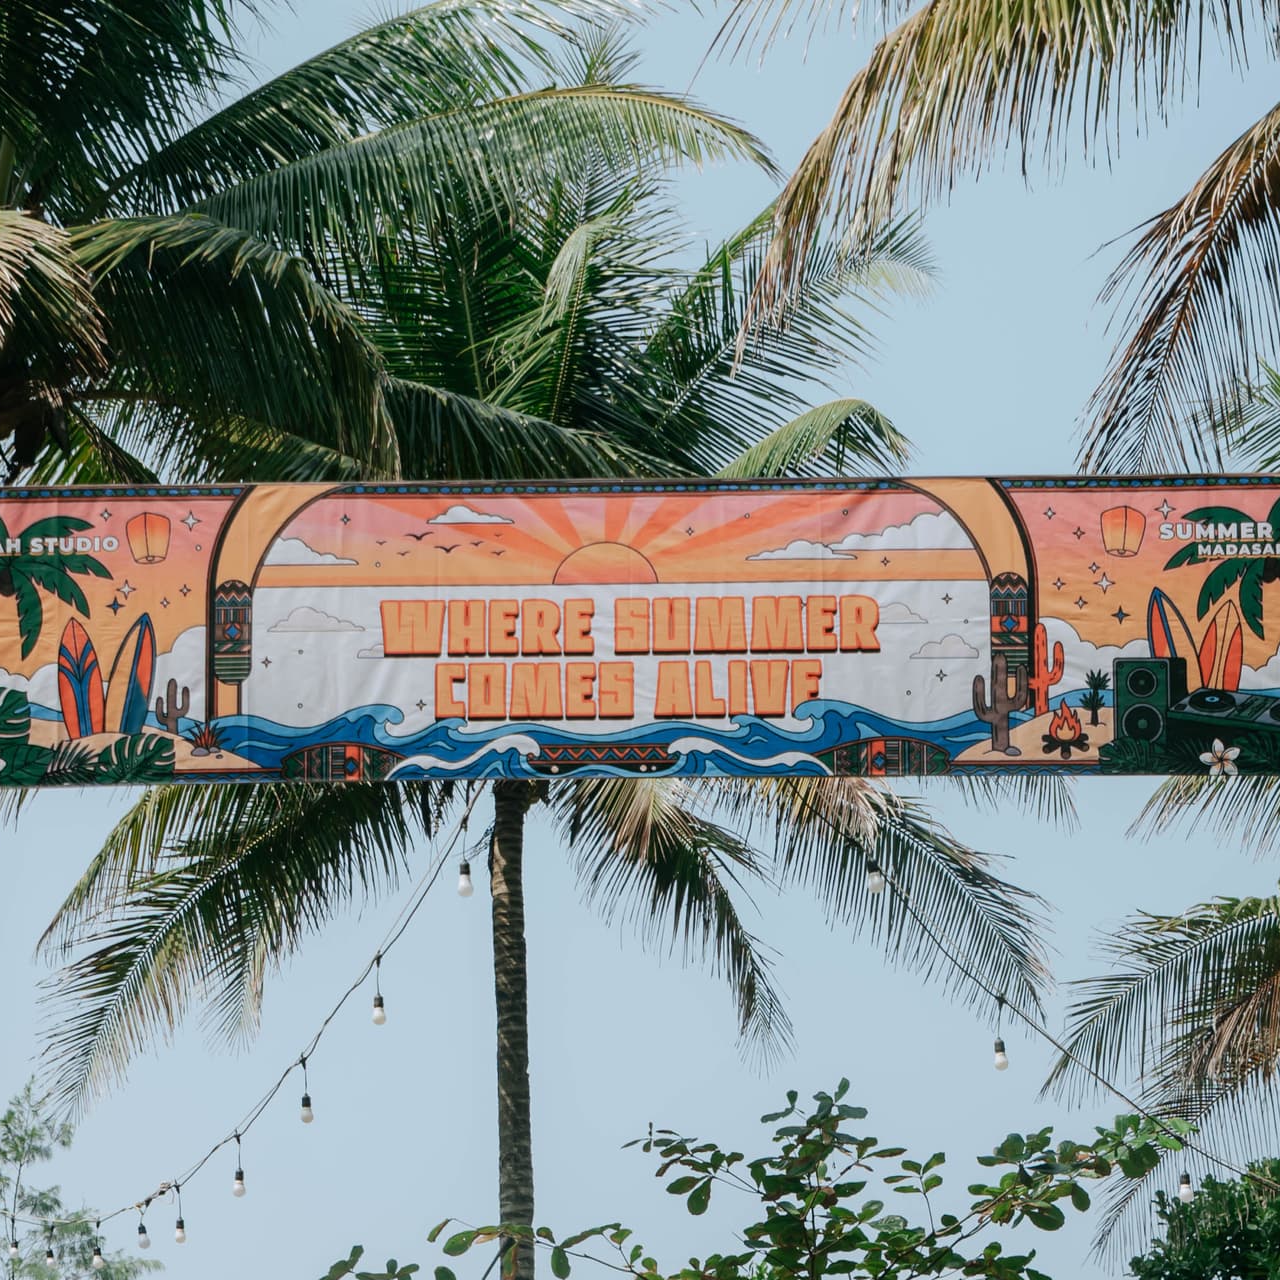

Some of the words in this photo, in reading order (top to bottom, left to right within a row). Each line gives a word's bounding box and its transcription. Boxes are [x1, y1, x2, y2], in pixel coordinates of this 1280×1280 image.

[29, 536, 119, 554] STUDIO
[1158, 521, 1273, 540] SUMMER
[380, 598, 595, 658] WHERE
[614, 594, 881, 655] SUMMER
[434, 661, 635, 721] COMES
[654, 658, 822, 720] ALIVE
